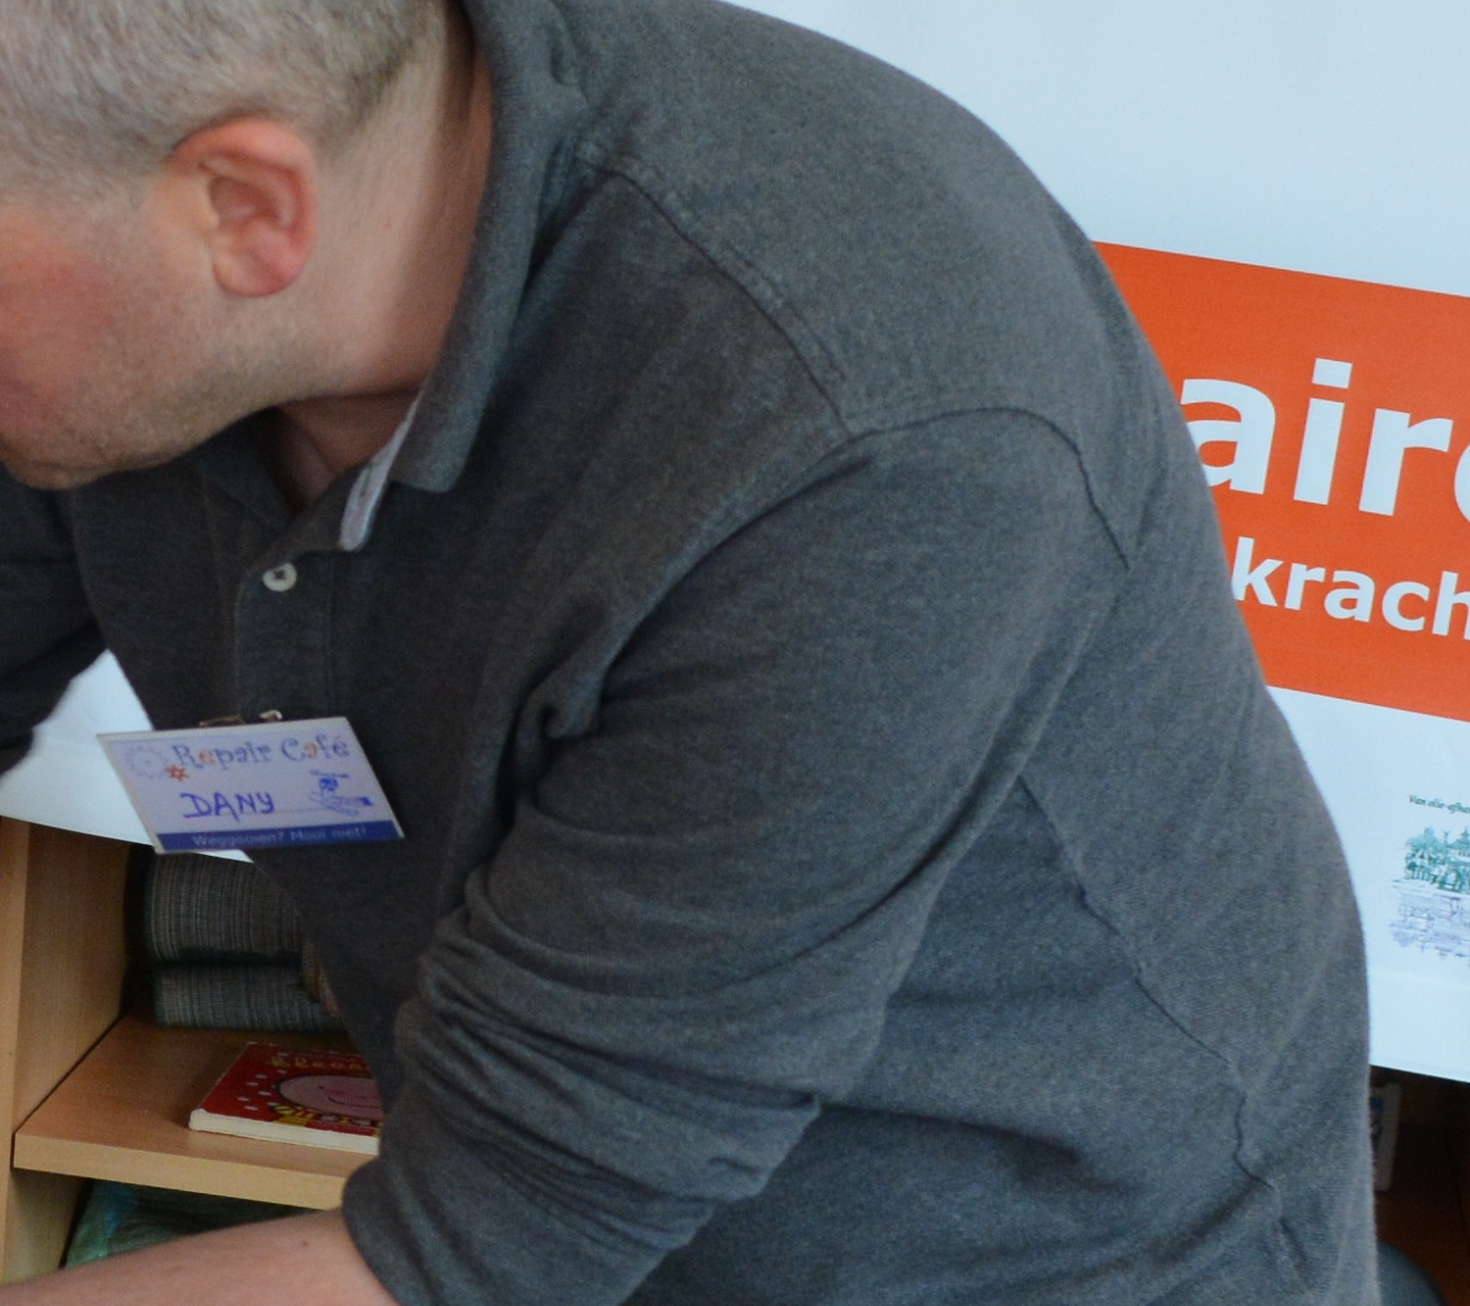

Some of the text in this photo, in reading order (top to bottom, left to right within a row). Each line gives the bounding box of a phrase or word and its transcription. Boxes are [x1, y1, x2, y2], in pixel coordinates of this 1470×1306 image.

[172, 733, 351, 772] Repair Café
[179, 791, 276, 822] DANY
[1409, 794, 1427, 807] Van
